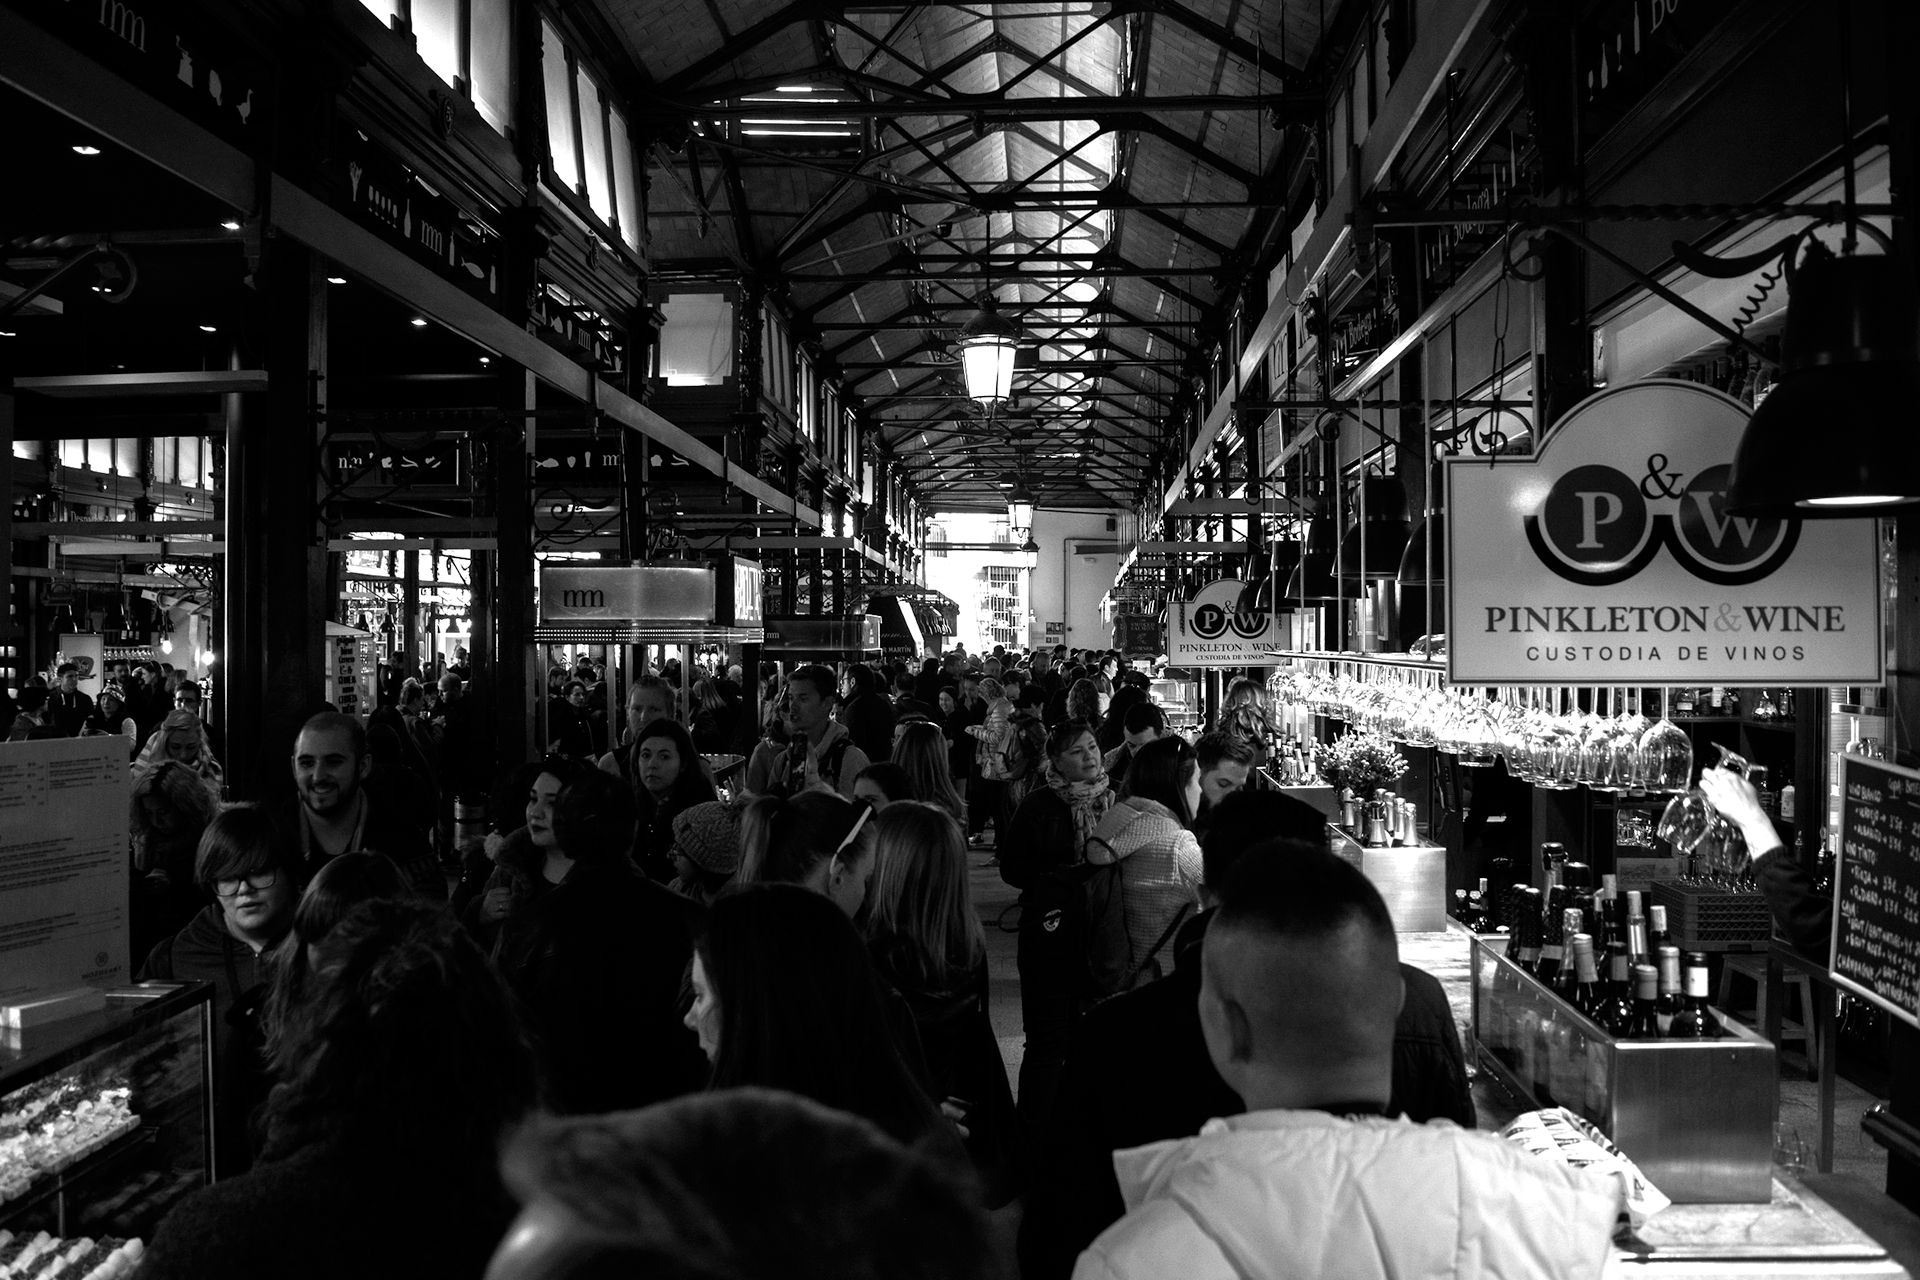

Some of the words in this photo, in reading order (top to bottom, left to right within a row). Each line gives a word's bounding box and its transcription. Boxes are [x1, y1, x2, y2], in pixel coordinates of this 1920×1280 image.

[1526, 646, 1662, 661] CUSTODIA
[1678, 646, 1708, 661] DE
[1725, 646, 1805, 661] VINOS
